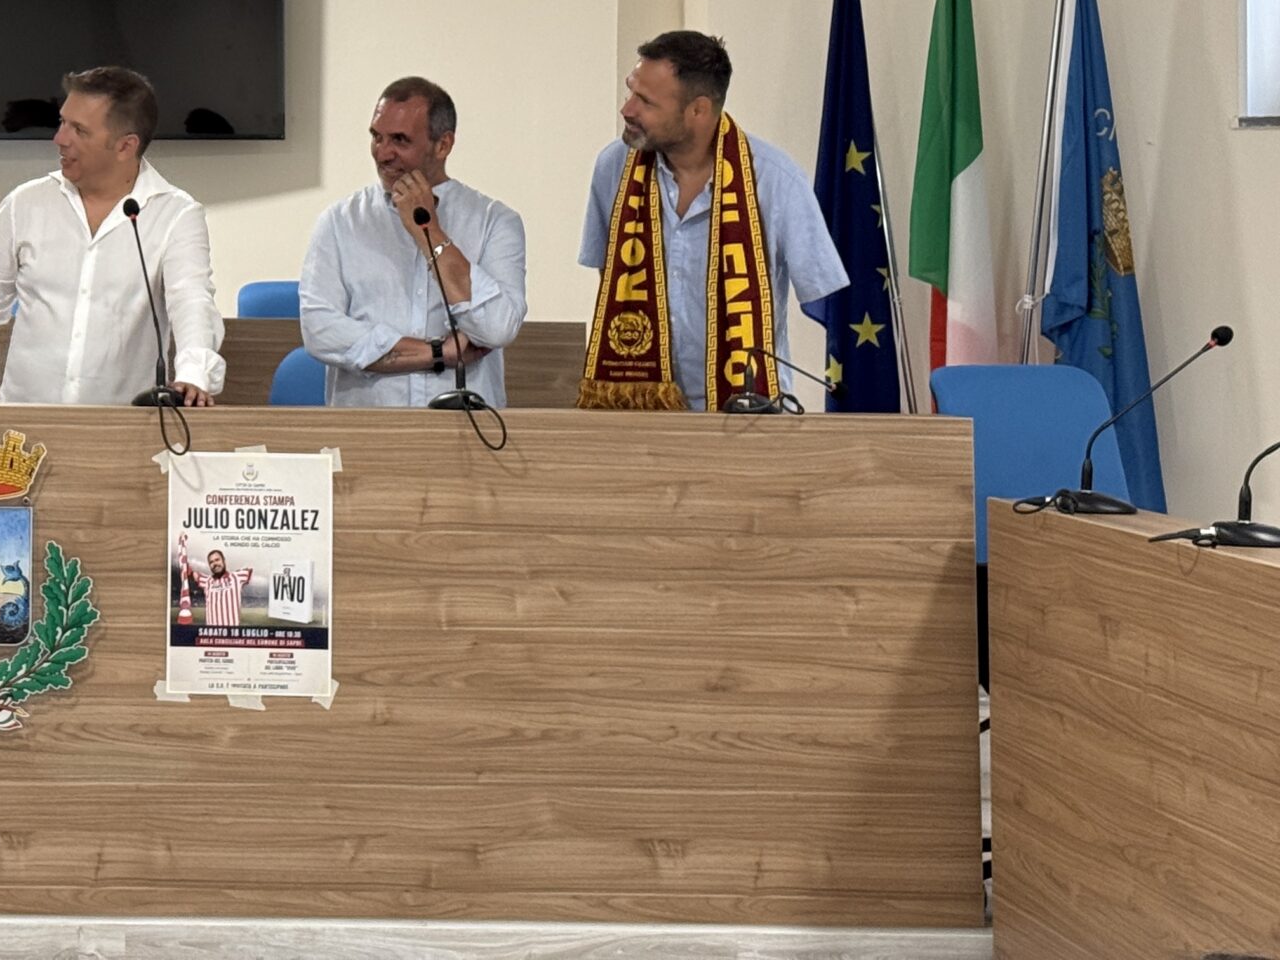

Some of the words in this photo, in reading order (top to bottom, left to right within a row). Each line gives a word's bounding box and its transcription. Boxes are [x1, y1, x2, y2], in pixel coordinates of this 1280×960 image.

[205, 494, 260, 506] CONFERENZA
[263, 495, 295, 506] STAMPA
[183, 507, 229, 529] JULIO
[235, 508, 320, 531] GONZALEZ
[198, 628, 228, 636] SABATO
[242, 628, 269, 637] LUGLIO
